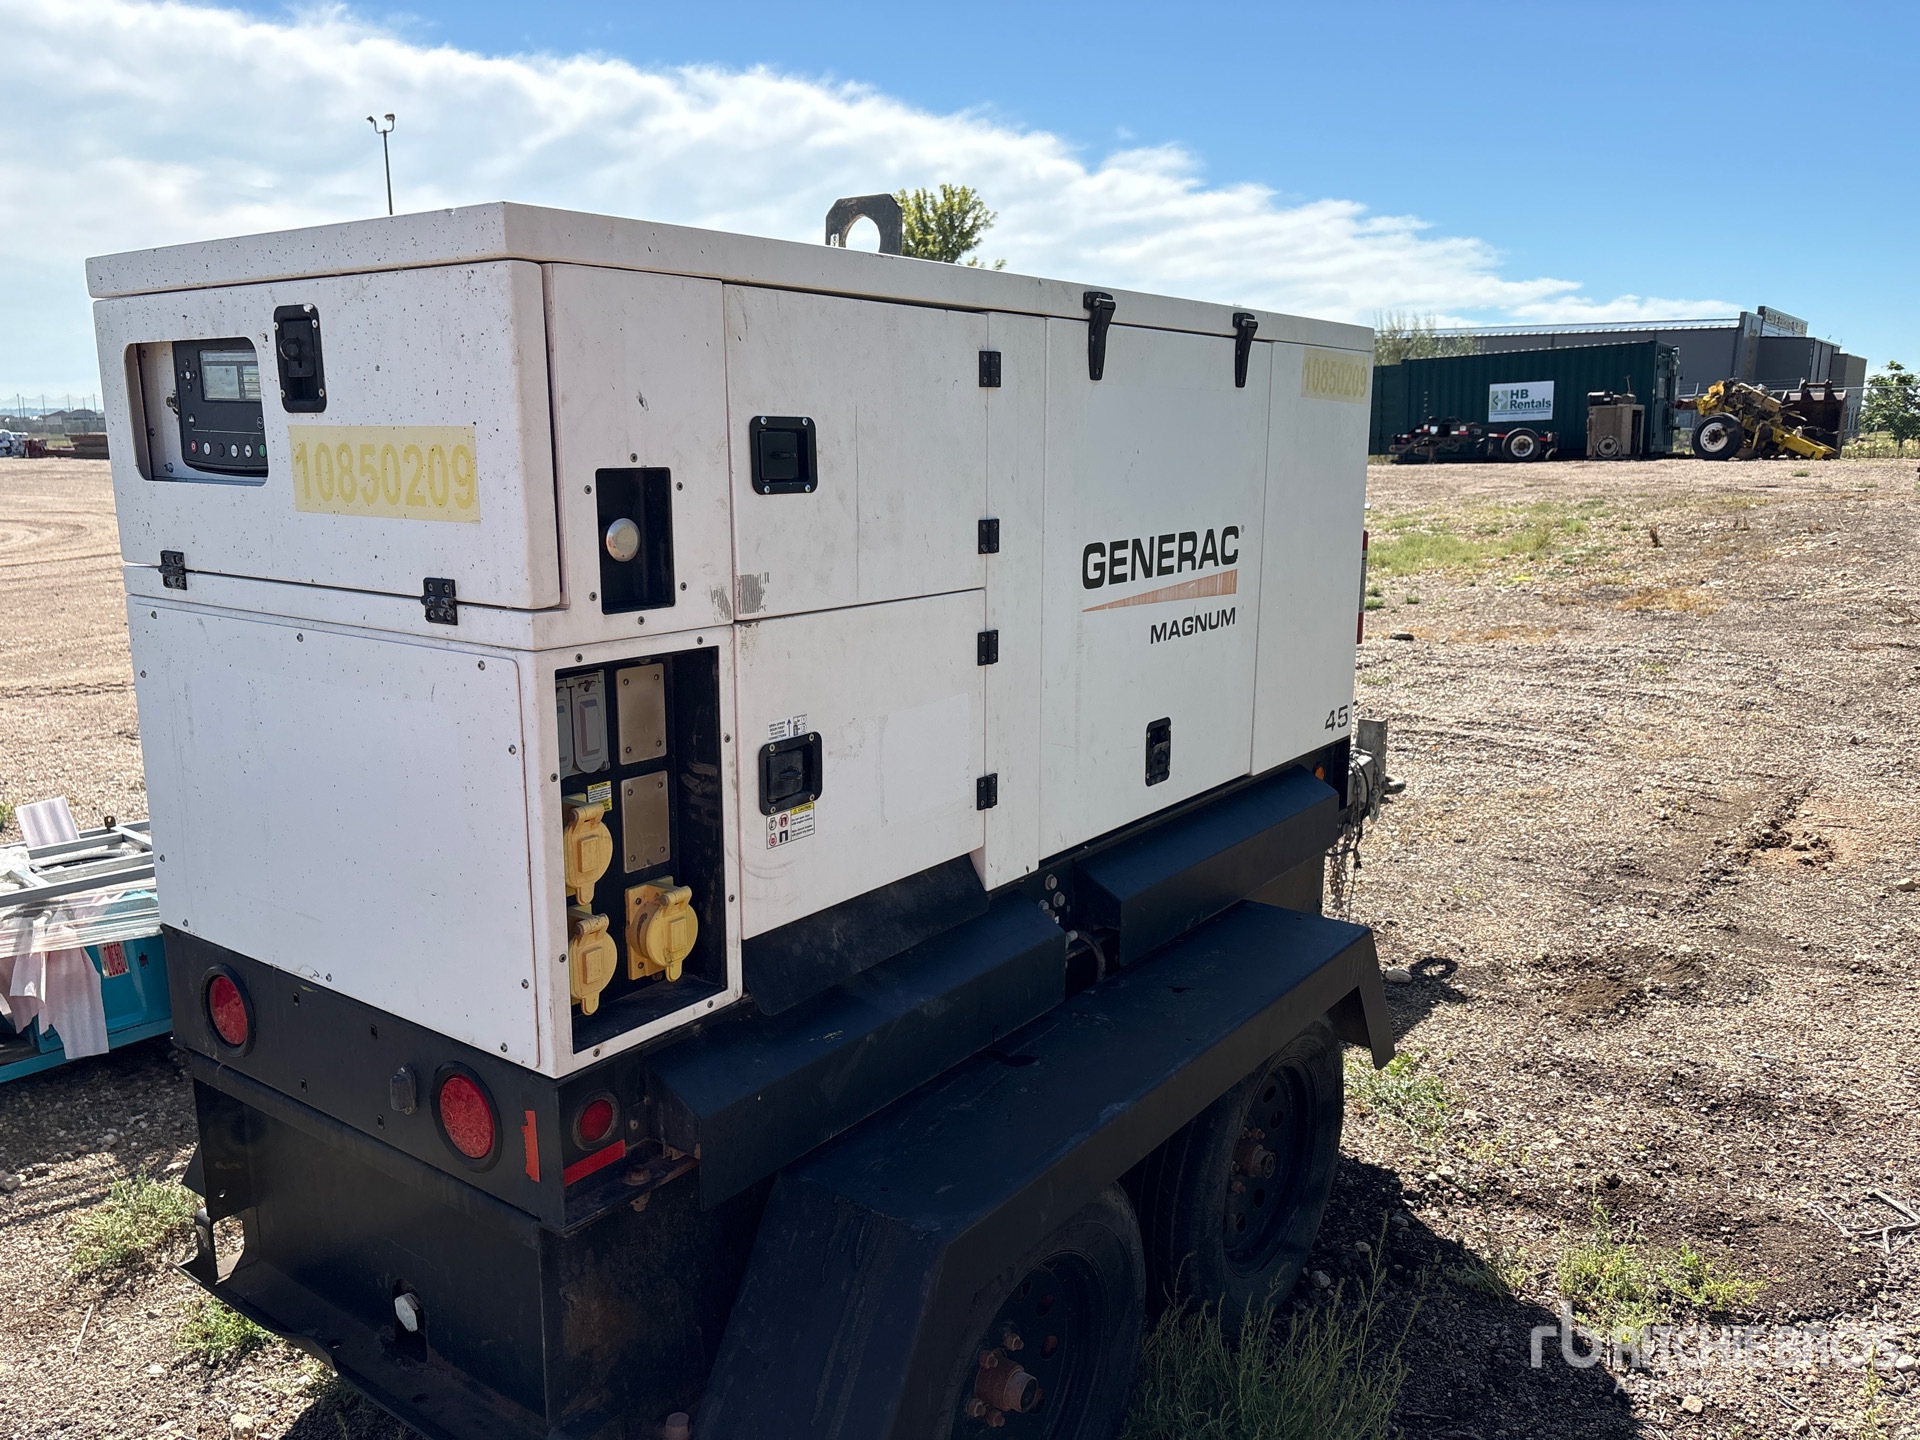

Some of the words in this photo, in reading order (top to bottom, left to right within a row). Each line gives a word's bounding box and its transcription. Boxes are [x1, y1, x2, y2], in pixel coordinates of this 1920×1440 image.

[1304, 357, 1367, 398] 10850209
[1510, 389, 1529, 399] HB
[1510, 398, 1552, 410] Rentals
[294, 441, 476, 510] 10850209
[1082, 525, 1239, 590] GENERAC
[1150, 607, 1236, 644] MAGNUM
[1324, 704, 1348, 731] 45
